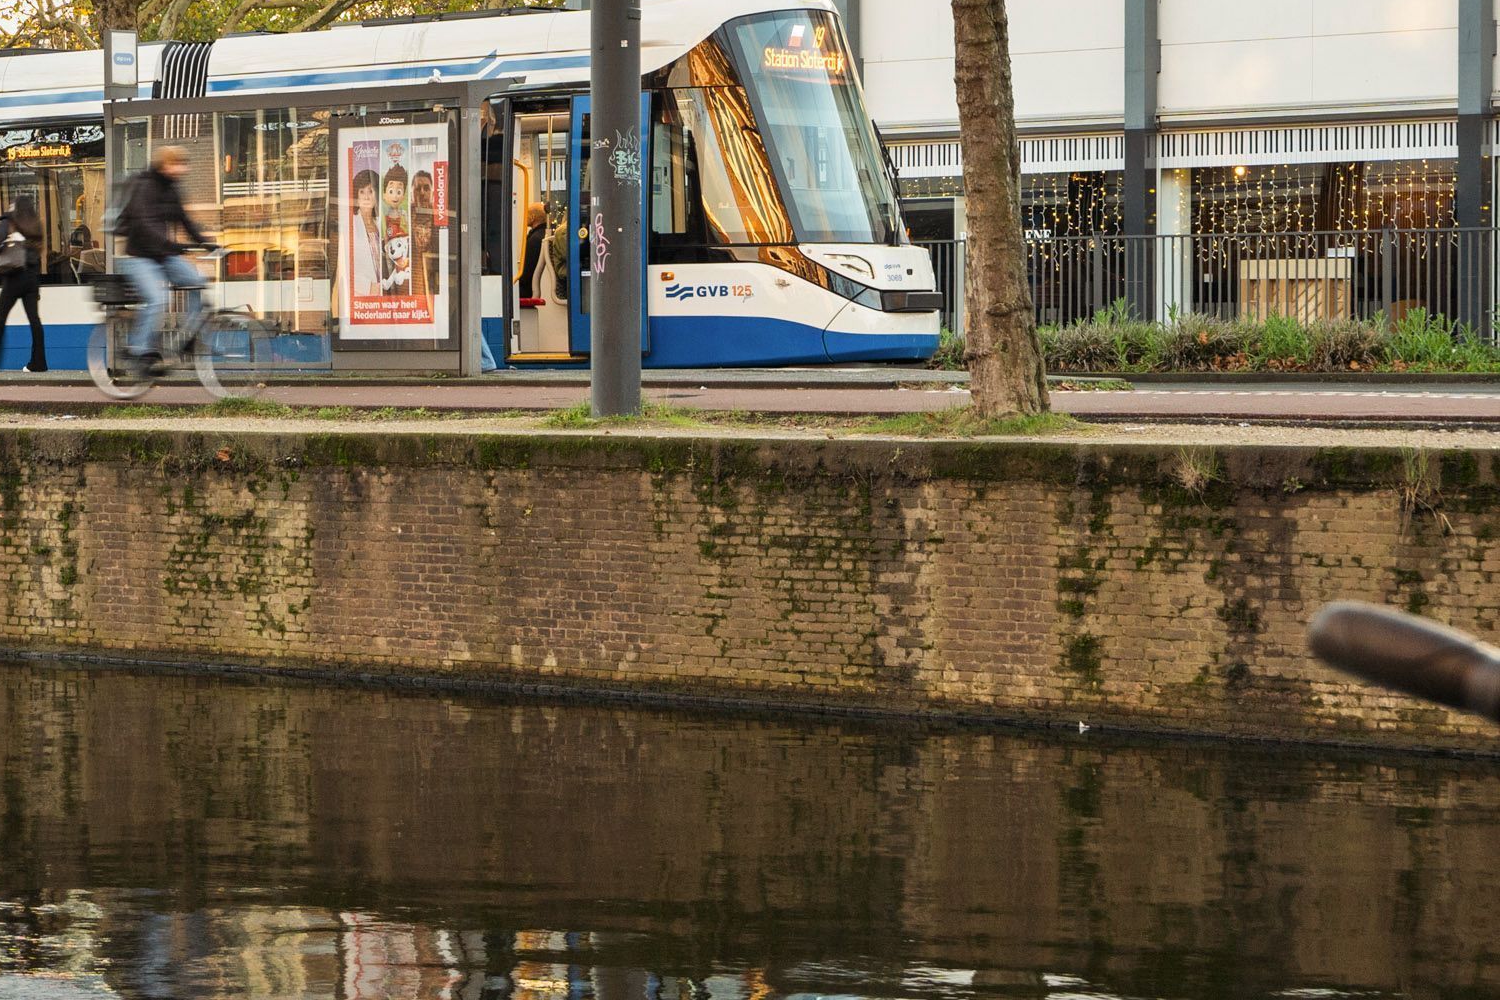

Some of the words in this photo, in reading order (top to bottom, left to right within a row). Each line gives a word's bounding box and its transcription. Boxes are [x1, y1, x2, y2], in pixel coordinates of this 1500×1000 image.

[813, 26, 825, 48] 19
[764, 48, 799, 68] Station
[800, 50, 845, 75] Sloterdijk
[379, 117, 405, 125] JCDecaux
[7, 147, 16, 160] 19
[19, 147, 40, 157] Station
[41, 145, 71, 157] Sloterdijk
[696, 285, 729, 297] GVB
[732, 285, 752, 296] 125
[353, 300, 380, 309] Stream
[400, 300, 418, 308] heel
[354, 310, 392, 320] Nederland
[393, 311, 411, 319] naar
[411, 310, 430, 321] kijkt.
